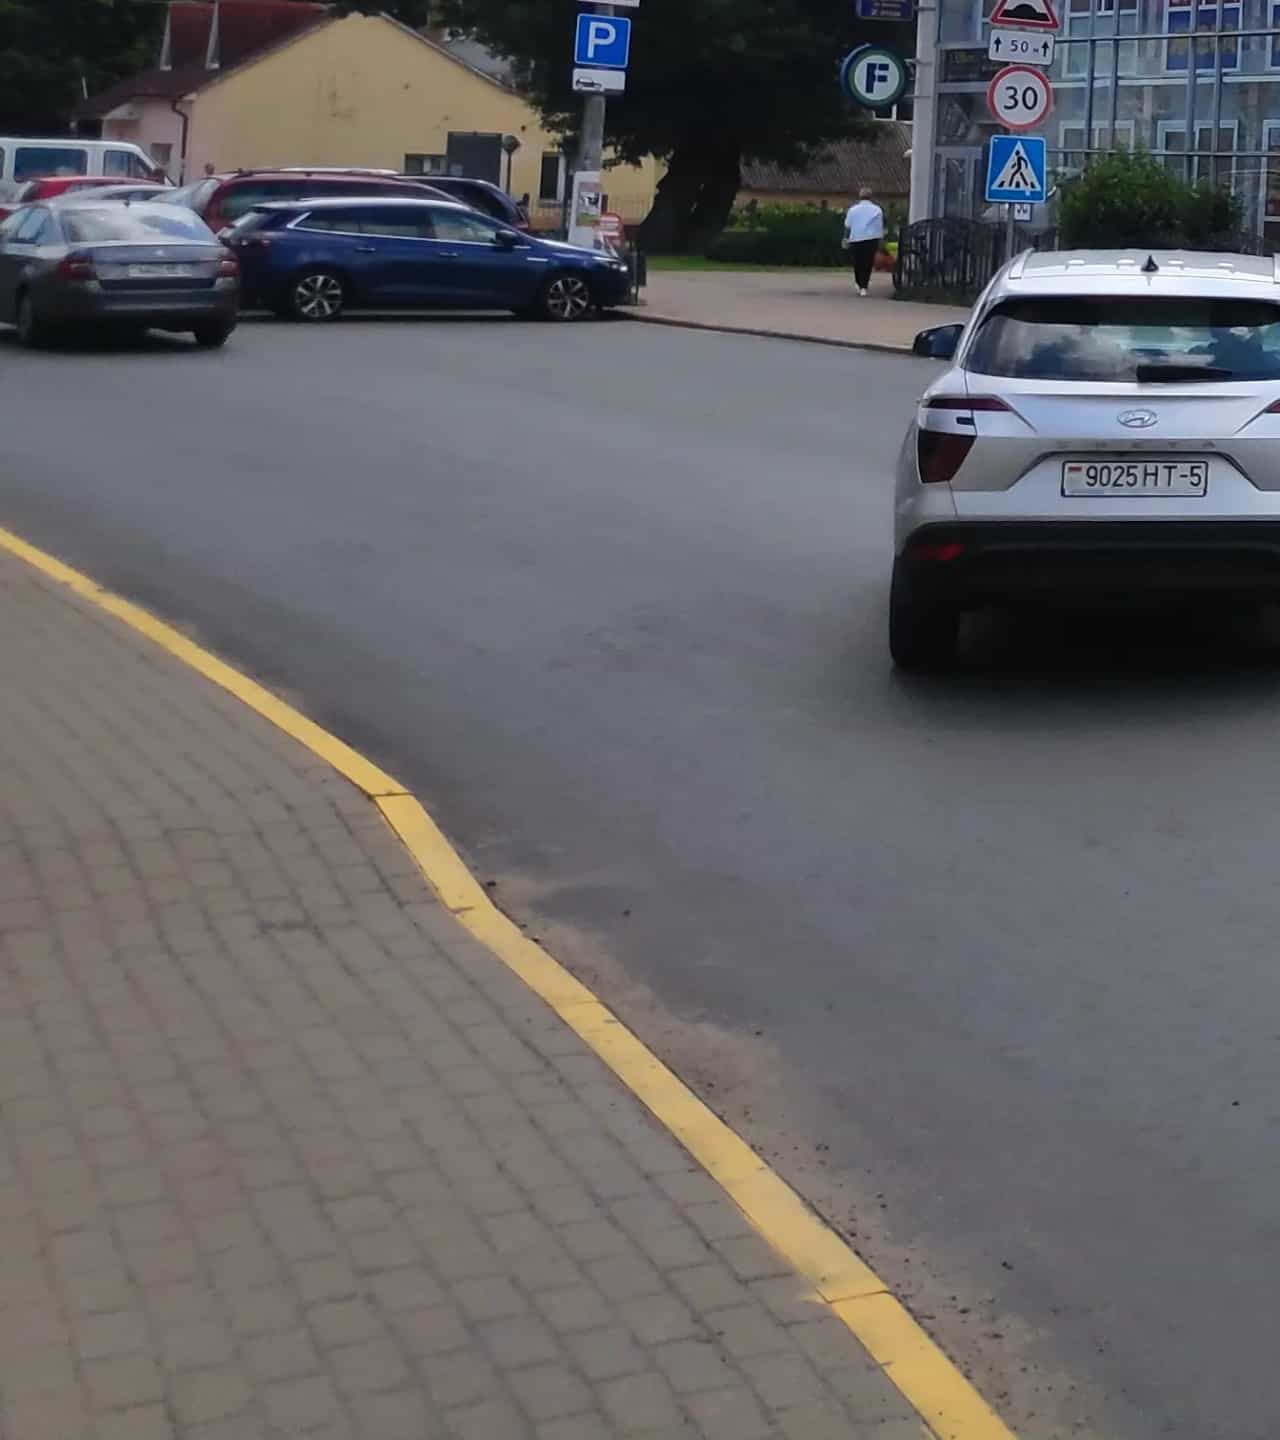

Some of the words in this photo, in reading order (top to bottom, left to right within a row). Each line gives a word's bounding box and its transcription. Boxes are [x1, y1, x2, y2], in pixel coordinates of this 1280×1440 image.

[588, 21, 616, 58] P
[1010, 40, 1029, 53] 50
[865, 62, 889, 94] F
[1003, 86, 1038, 110] 30
[1086, 465, 1138, 487] 9025
